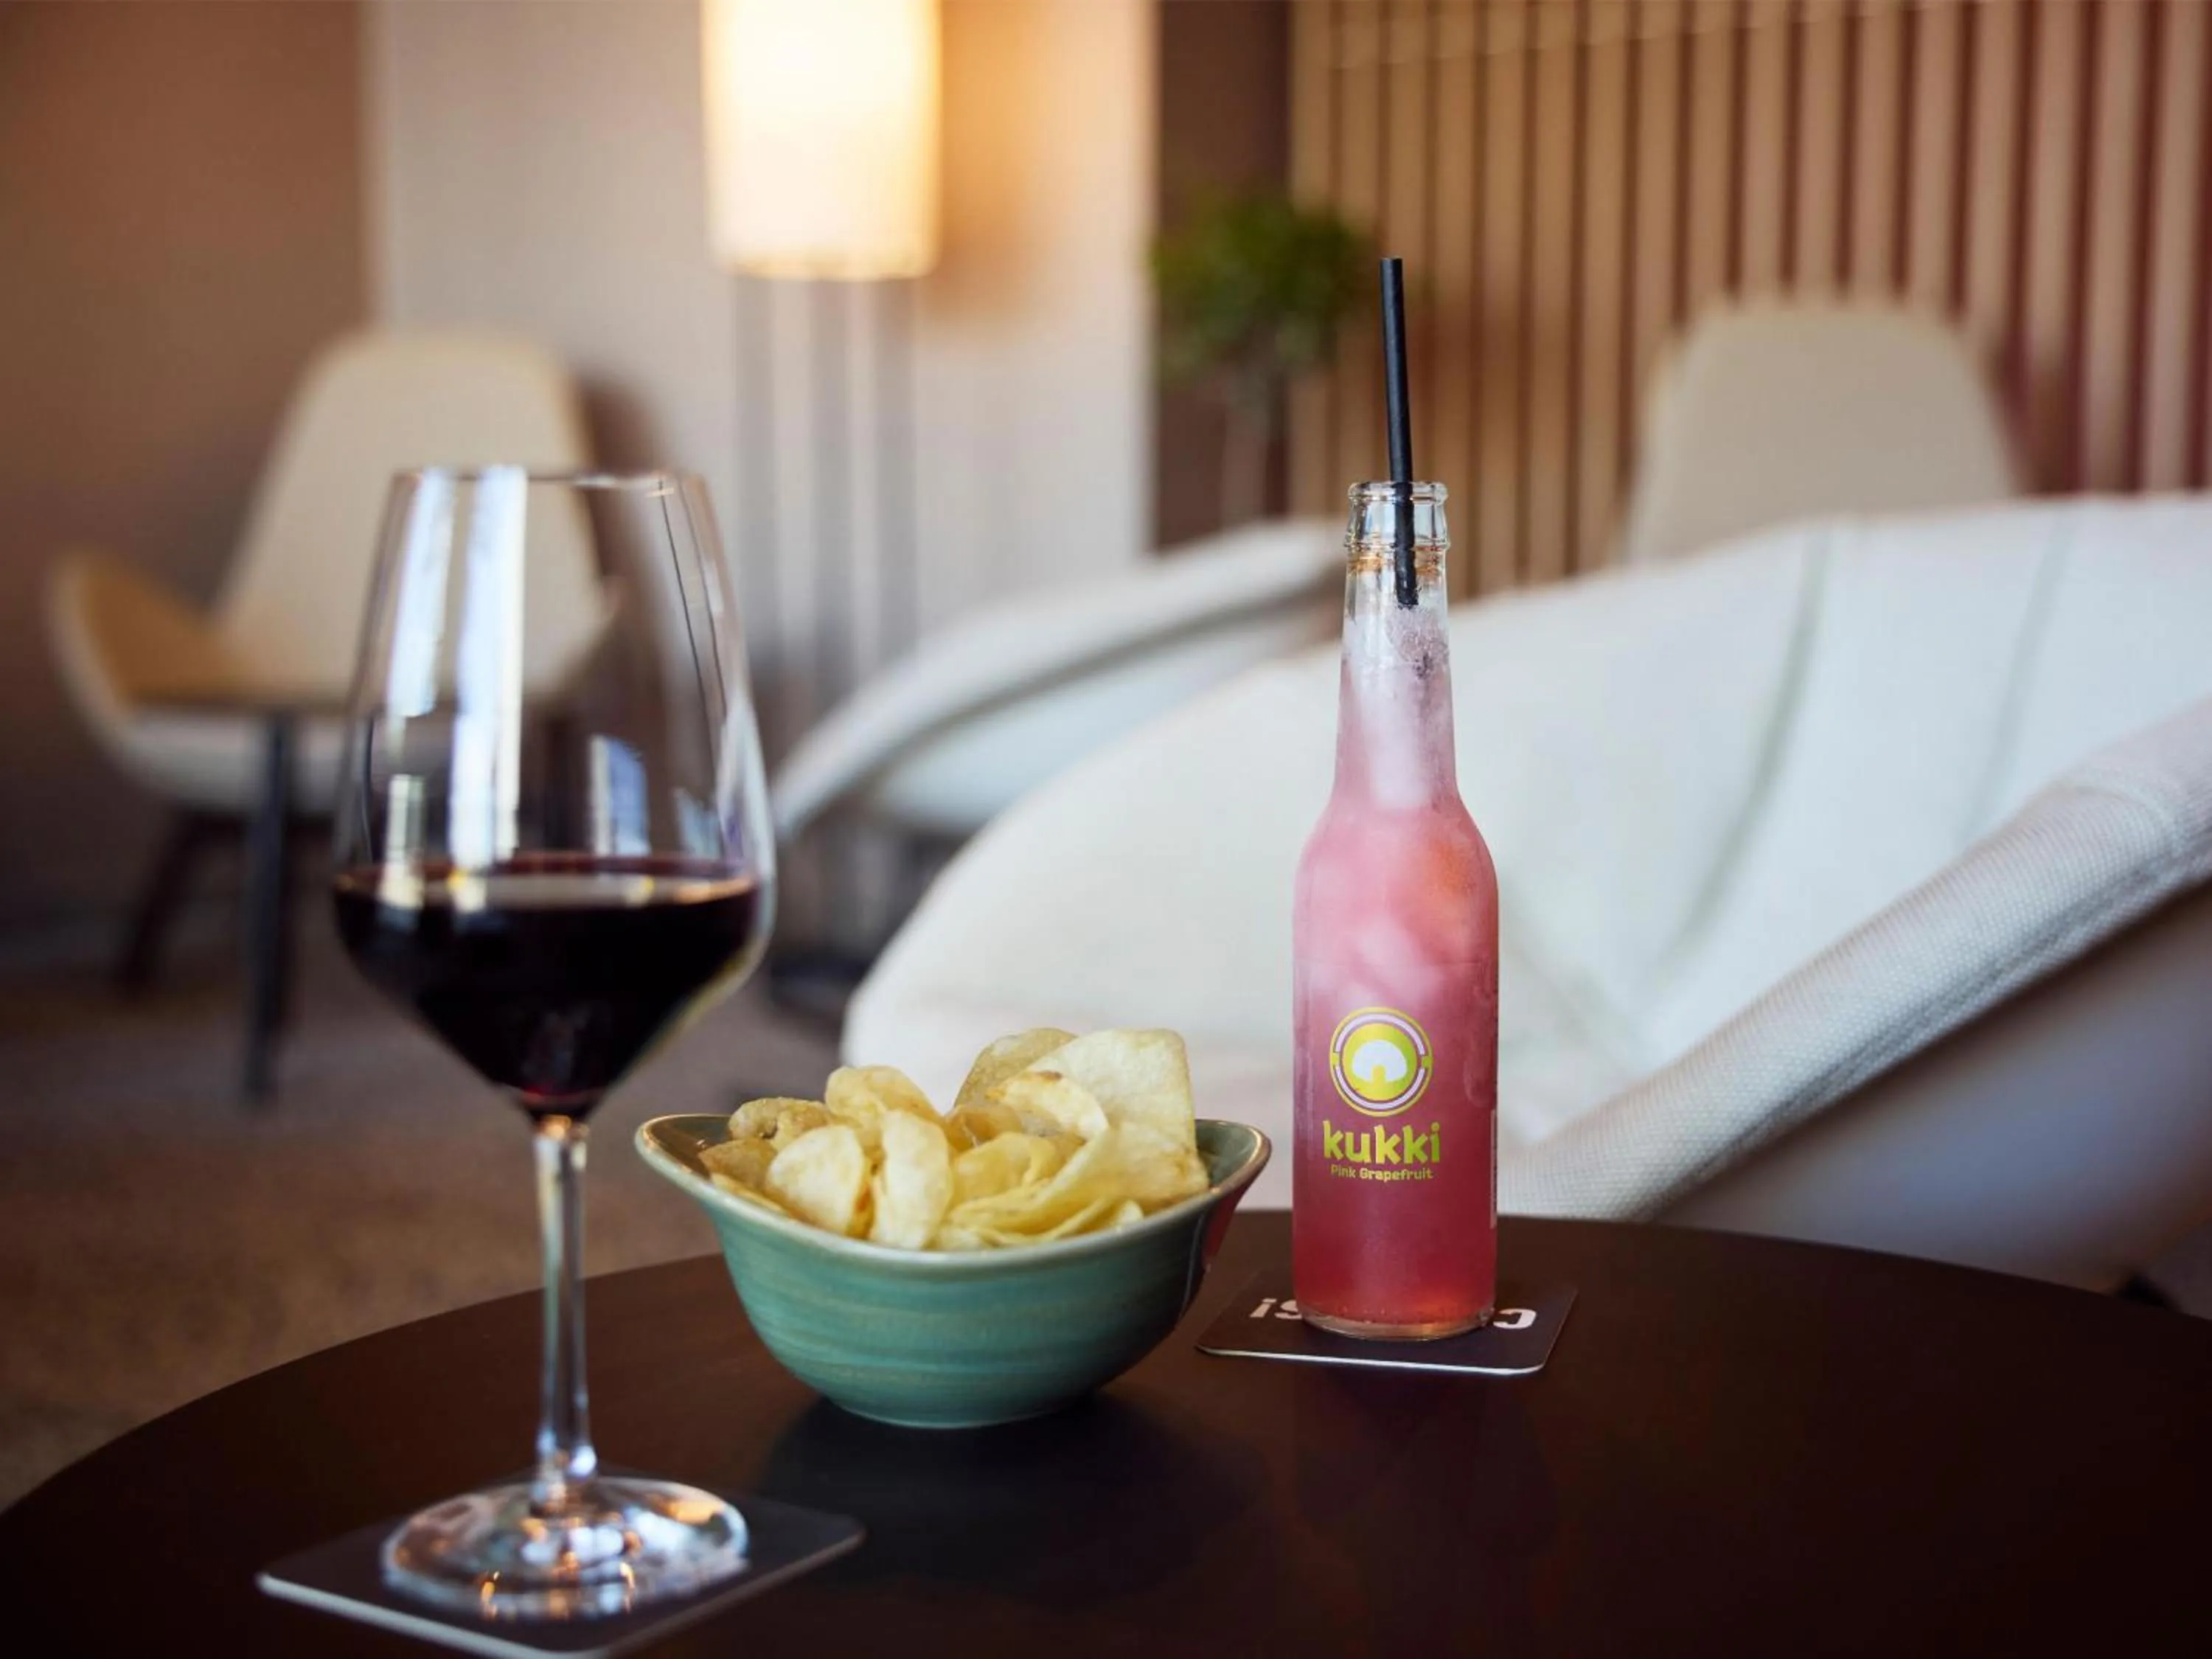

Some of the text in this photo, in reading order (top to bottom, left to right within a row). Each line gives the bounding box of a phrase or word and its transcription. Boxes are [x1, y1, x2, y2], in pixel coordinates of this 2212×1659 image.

[1323, 1120, 1440, 1164] kukki
[1331, 1164, 1433, 1182] Pink Grapefruit
